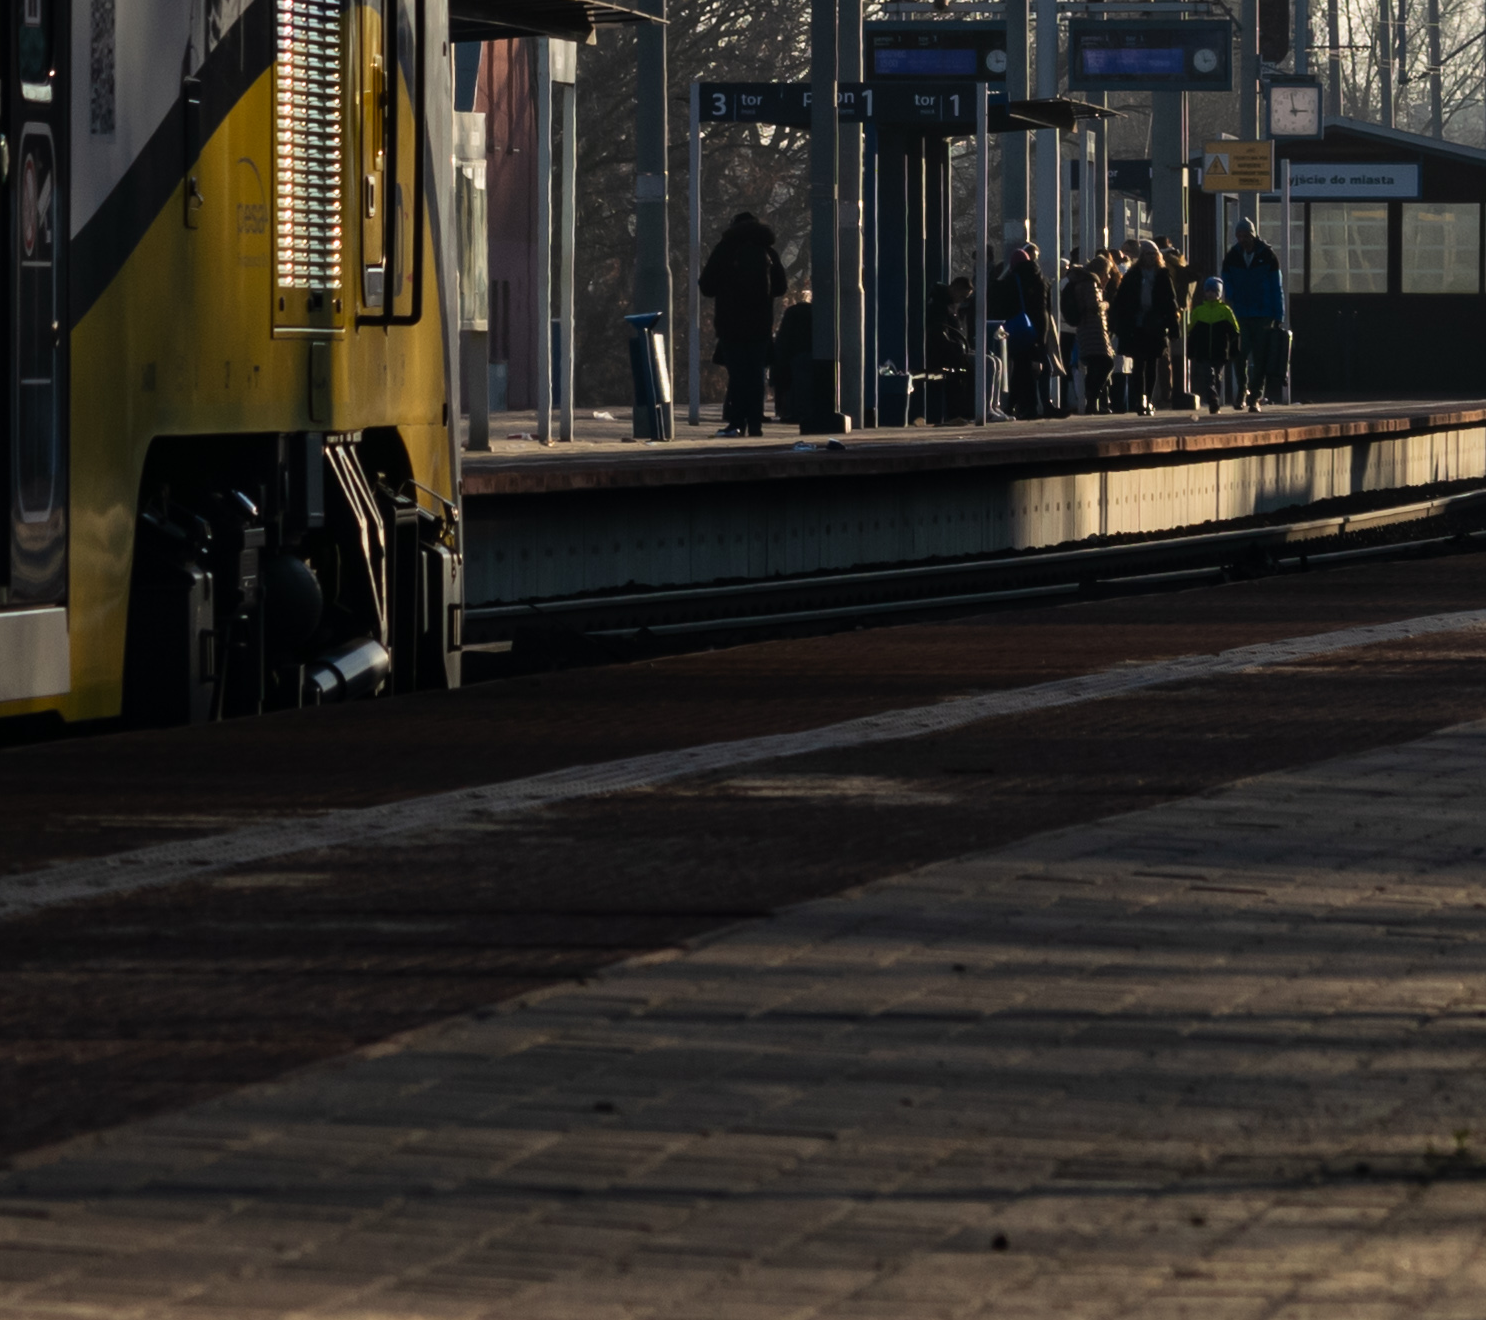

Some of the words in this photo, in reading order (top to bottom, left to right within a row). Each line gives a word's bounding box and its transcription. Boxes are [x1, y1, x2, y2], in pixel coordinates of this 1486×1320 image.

[711, 92, 727, 116] 3
[741, 94, 763, 106] tor
[861, 89, 874, 117] 1
[914, 94, 936, 106] tor
[949, 94, 960, 117] 1
[1330, 175, 1346, 185] do
[1349, 174, 1395, 185] miasta
